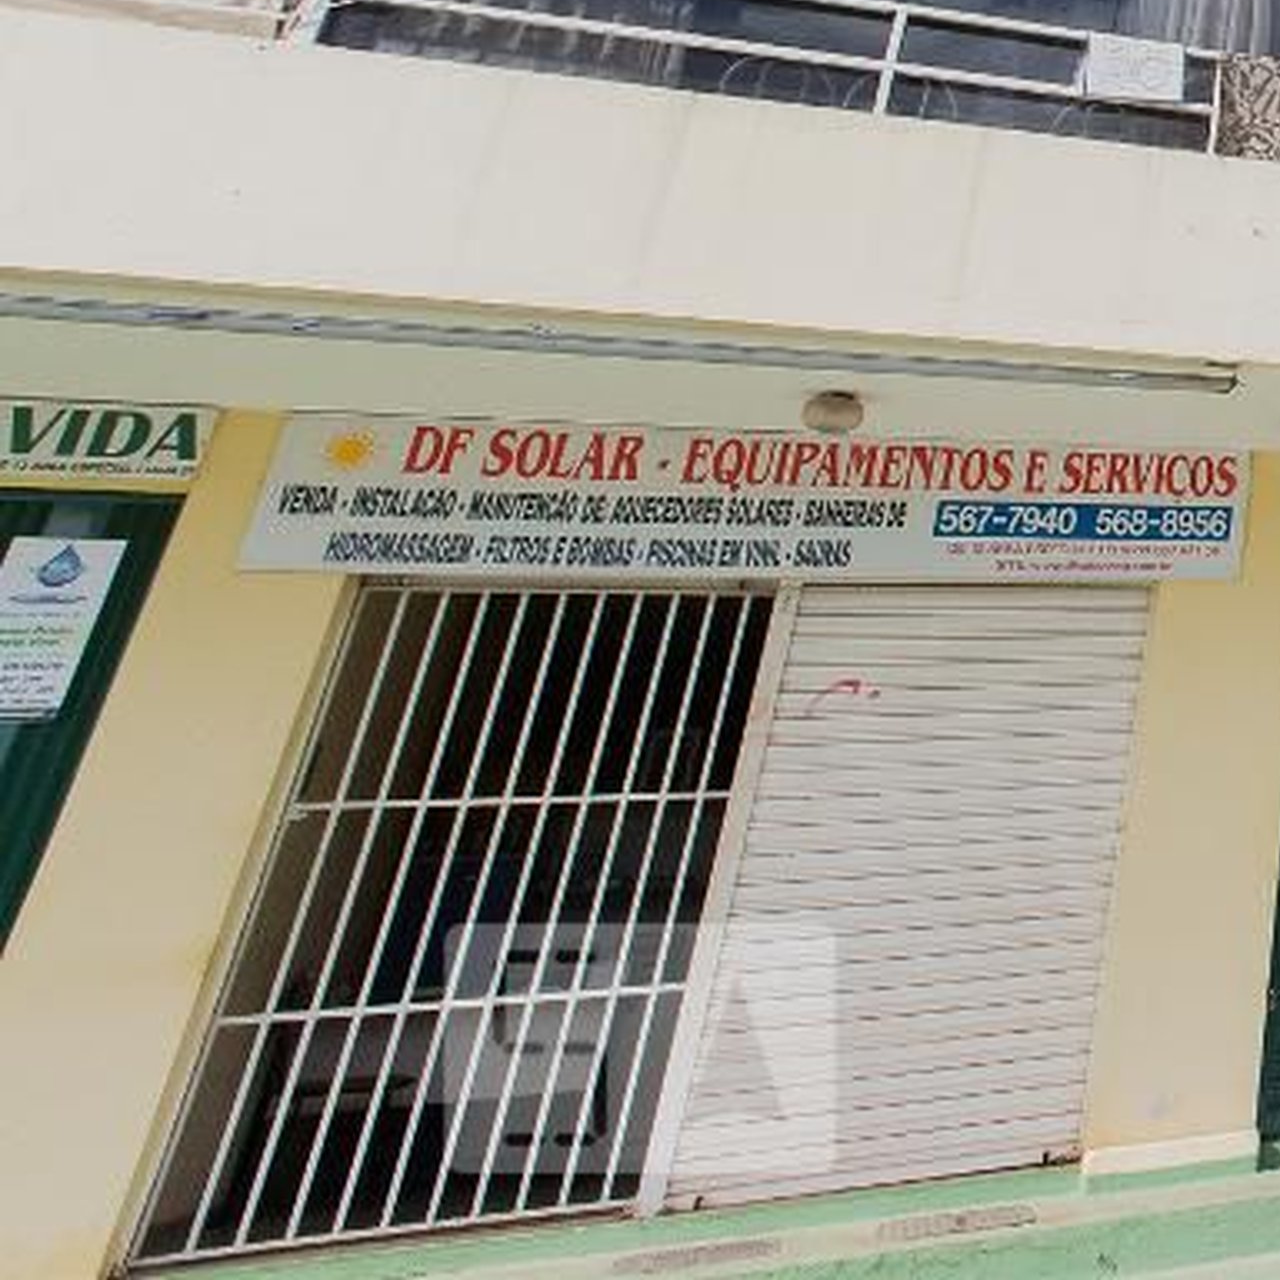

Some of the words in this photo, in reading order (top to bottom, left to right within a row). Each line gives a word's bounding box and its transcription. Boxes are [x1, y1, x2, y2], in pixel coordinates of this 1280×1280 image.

[10, 405, 198, 461] VIDA
[403, 426, 473, 475] DF
[481, 428, 644, 482] SOLAR
[681, 437, 1013, 492] EQUIPAMENTOS
[1024, 450, 1047, 492] E
[278, 486, 340, 514] VENDA
[580, 494, 608, 523] DE
[725, 497, 794, 527] SOLARES
[939, 505, 1077, 536] 567-7940
[1095, 508, 1229, 538] 568-8956
[482, 536, 551, 565] FILTROS
